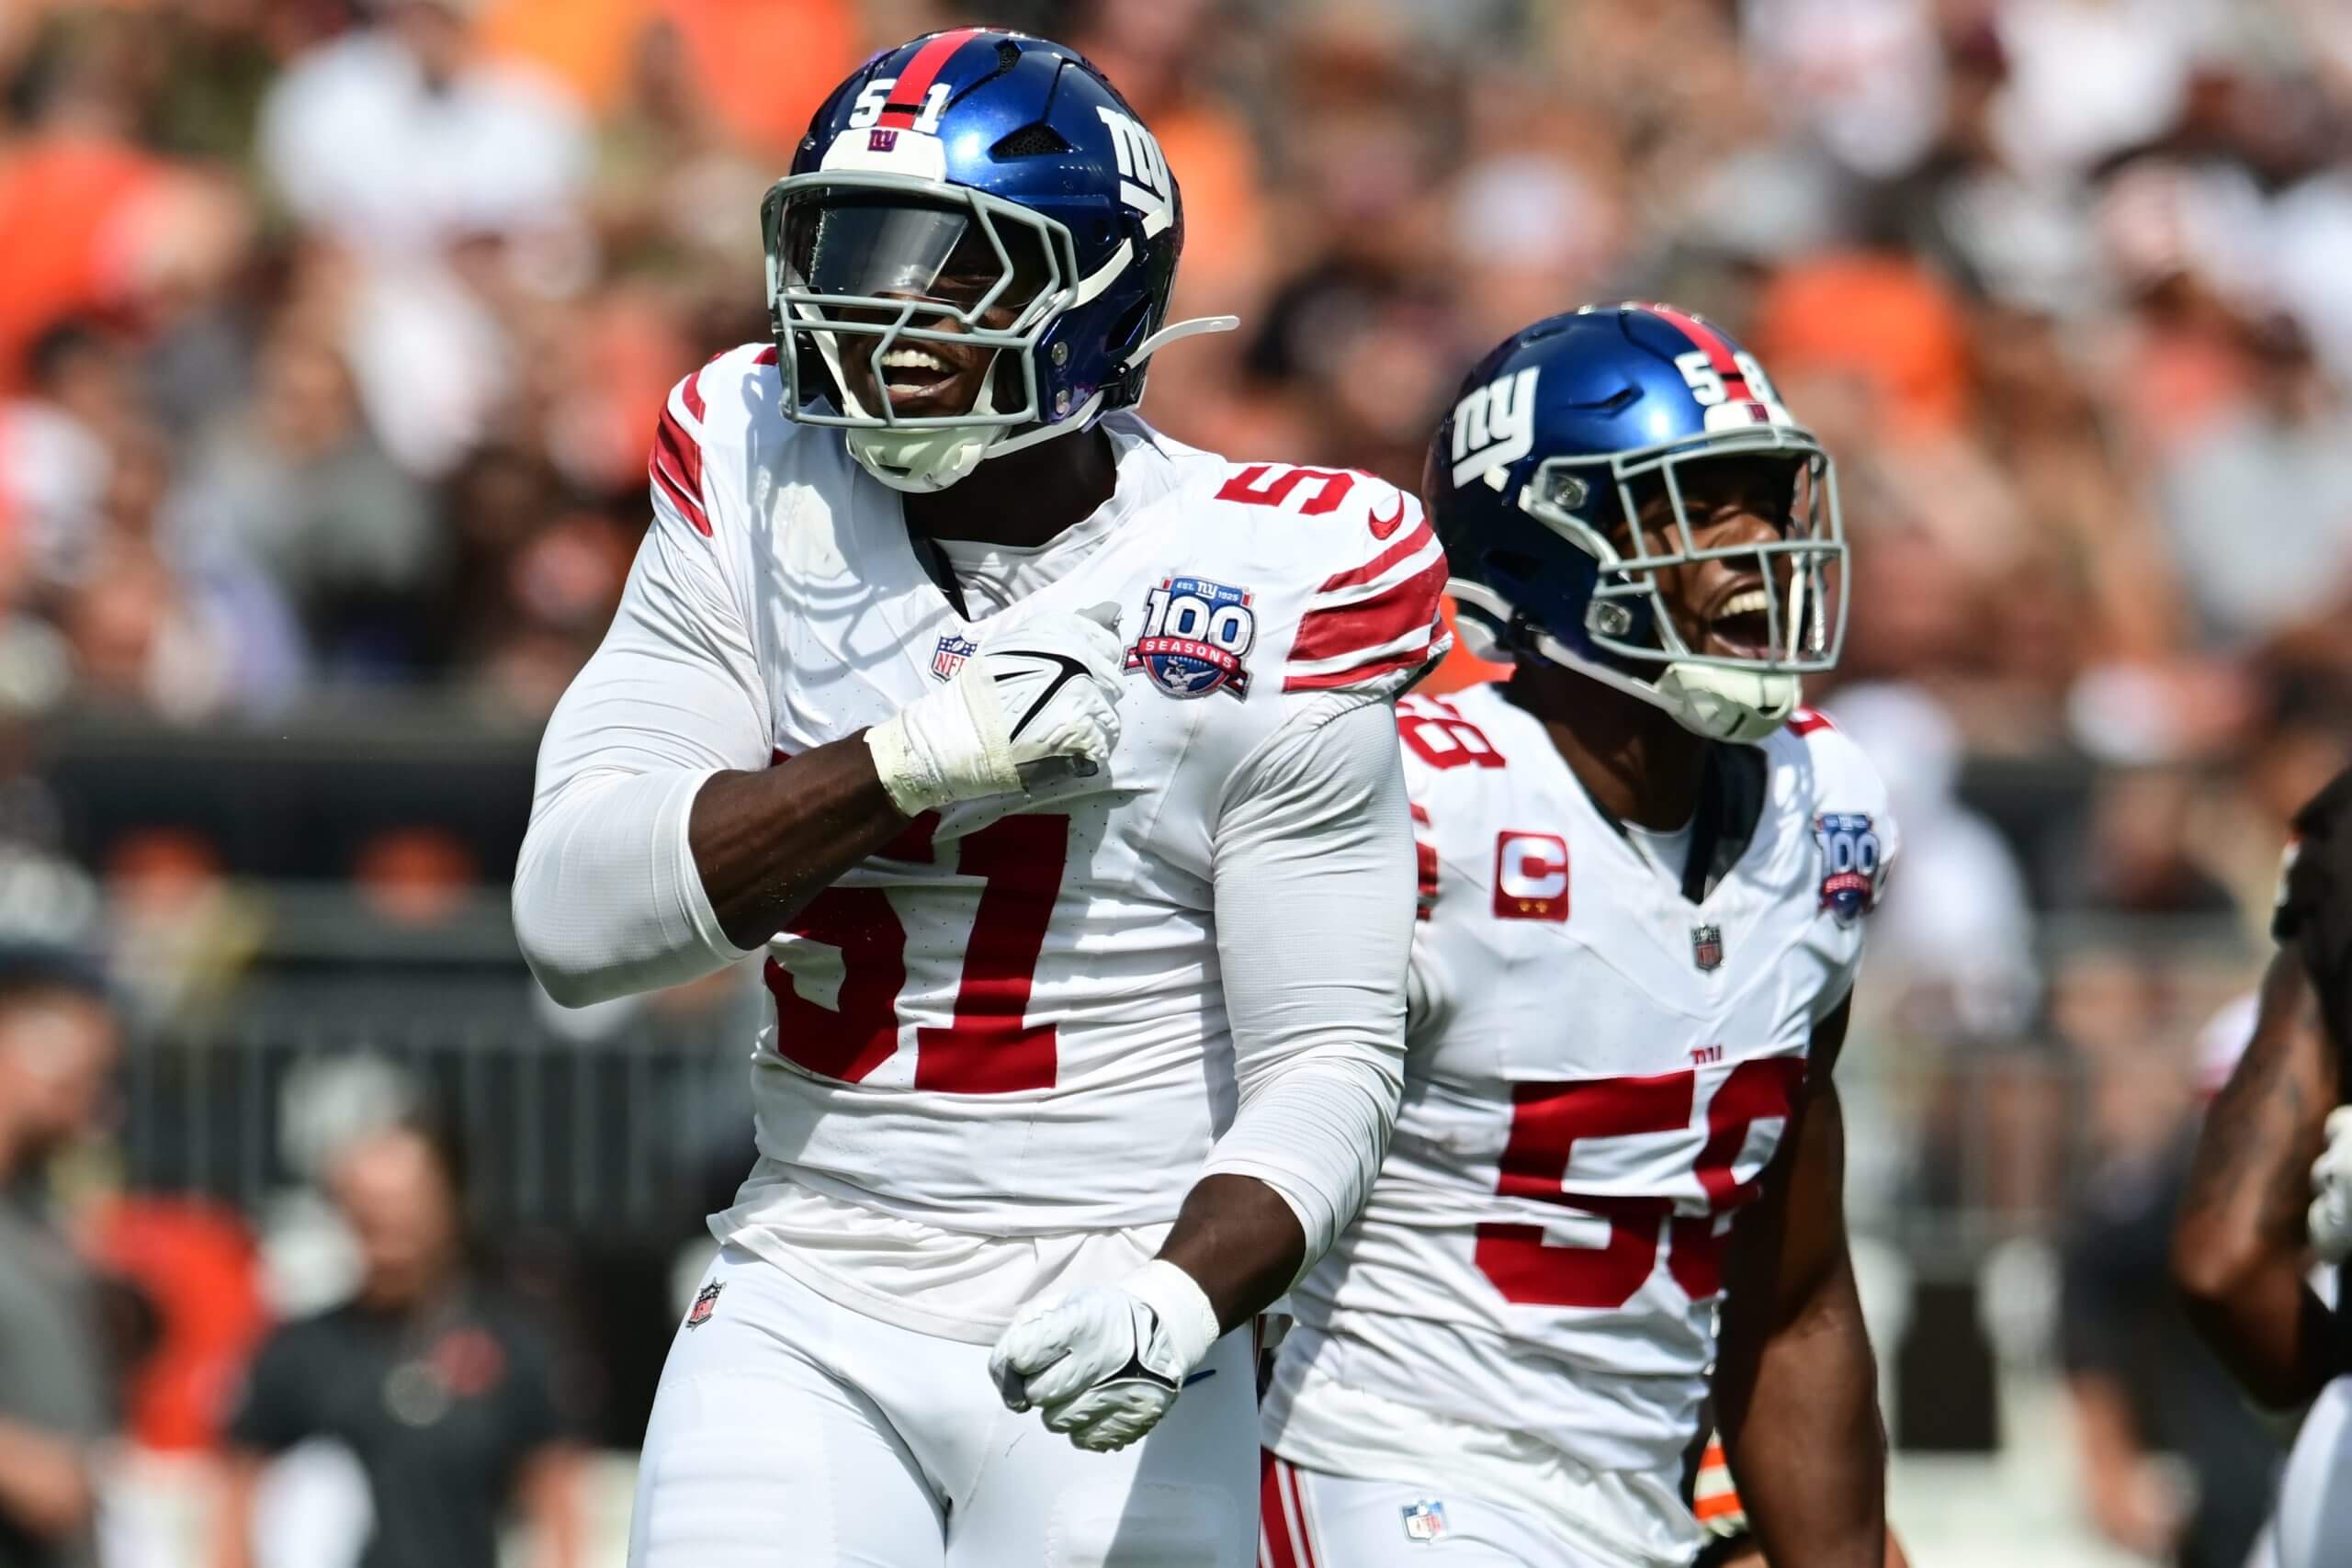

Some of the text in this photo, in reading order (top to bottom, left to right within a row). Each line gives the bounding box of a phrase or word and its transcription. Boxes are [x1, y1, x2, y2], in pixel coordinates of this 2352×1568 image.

[849, 78, 952, 134] 51
[1674, 347, 1777, 406] 58
[1214, 466, 1380, 515] 5
[1144, 588, 1252, 656] 100
[1217, 590, 1238, 602] 1925
[1146, 640, 1233, 669] SEASONS
[1500, 835, 1567, 898] C
[1815, 831, 1880, 877] 100
